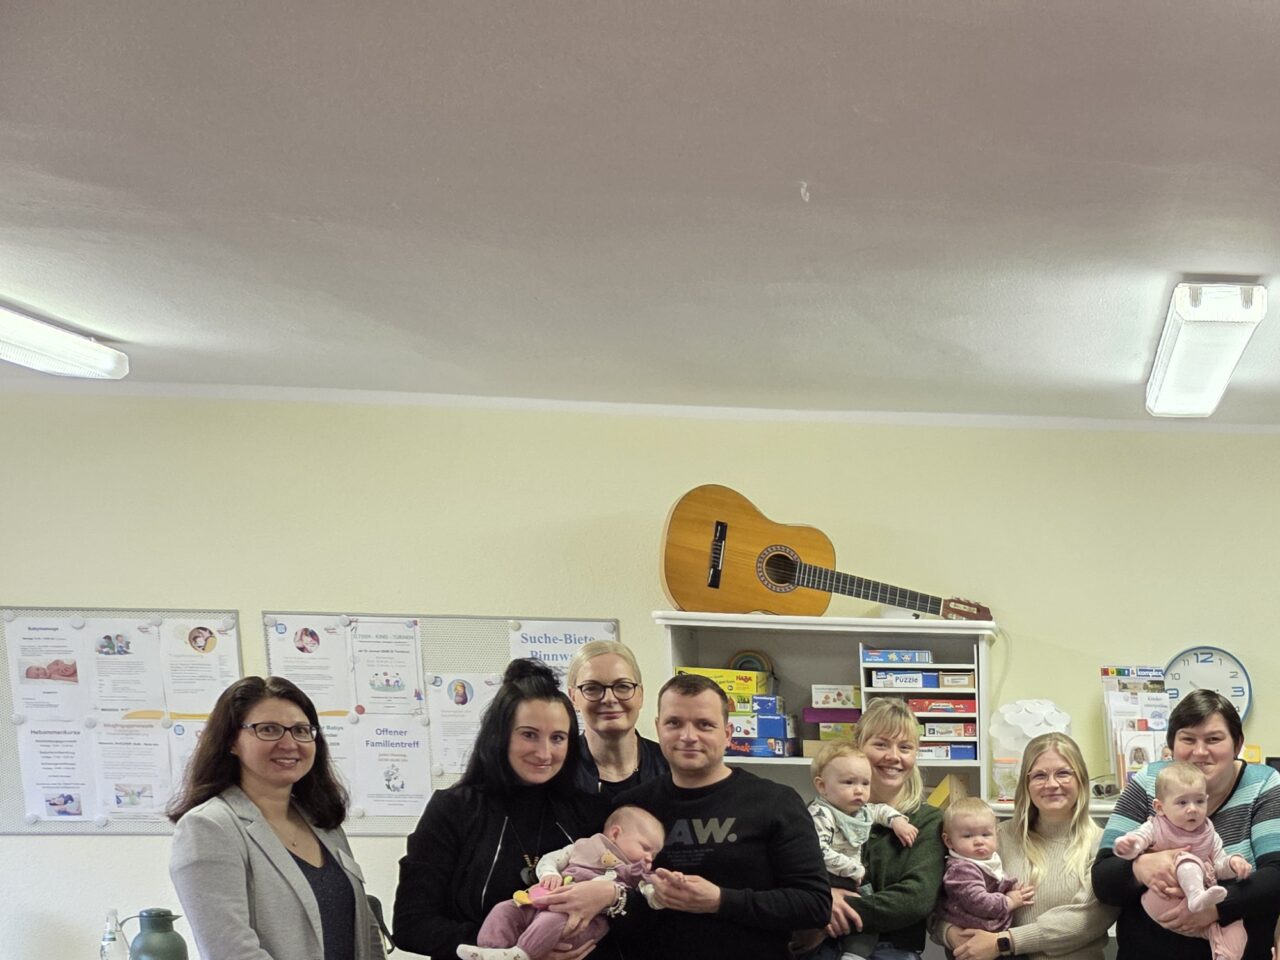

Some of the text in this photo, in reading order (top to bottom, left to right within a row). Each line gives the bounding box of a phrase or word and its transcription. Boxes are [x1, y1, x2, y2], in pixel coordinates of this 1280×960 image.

[1193, 652, 1214, 664] 12
[1171, 671, 1239, 680] 10 2
[1231, 686, 1245, 698] 3
[375, 727, 408, 737] Offener
